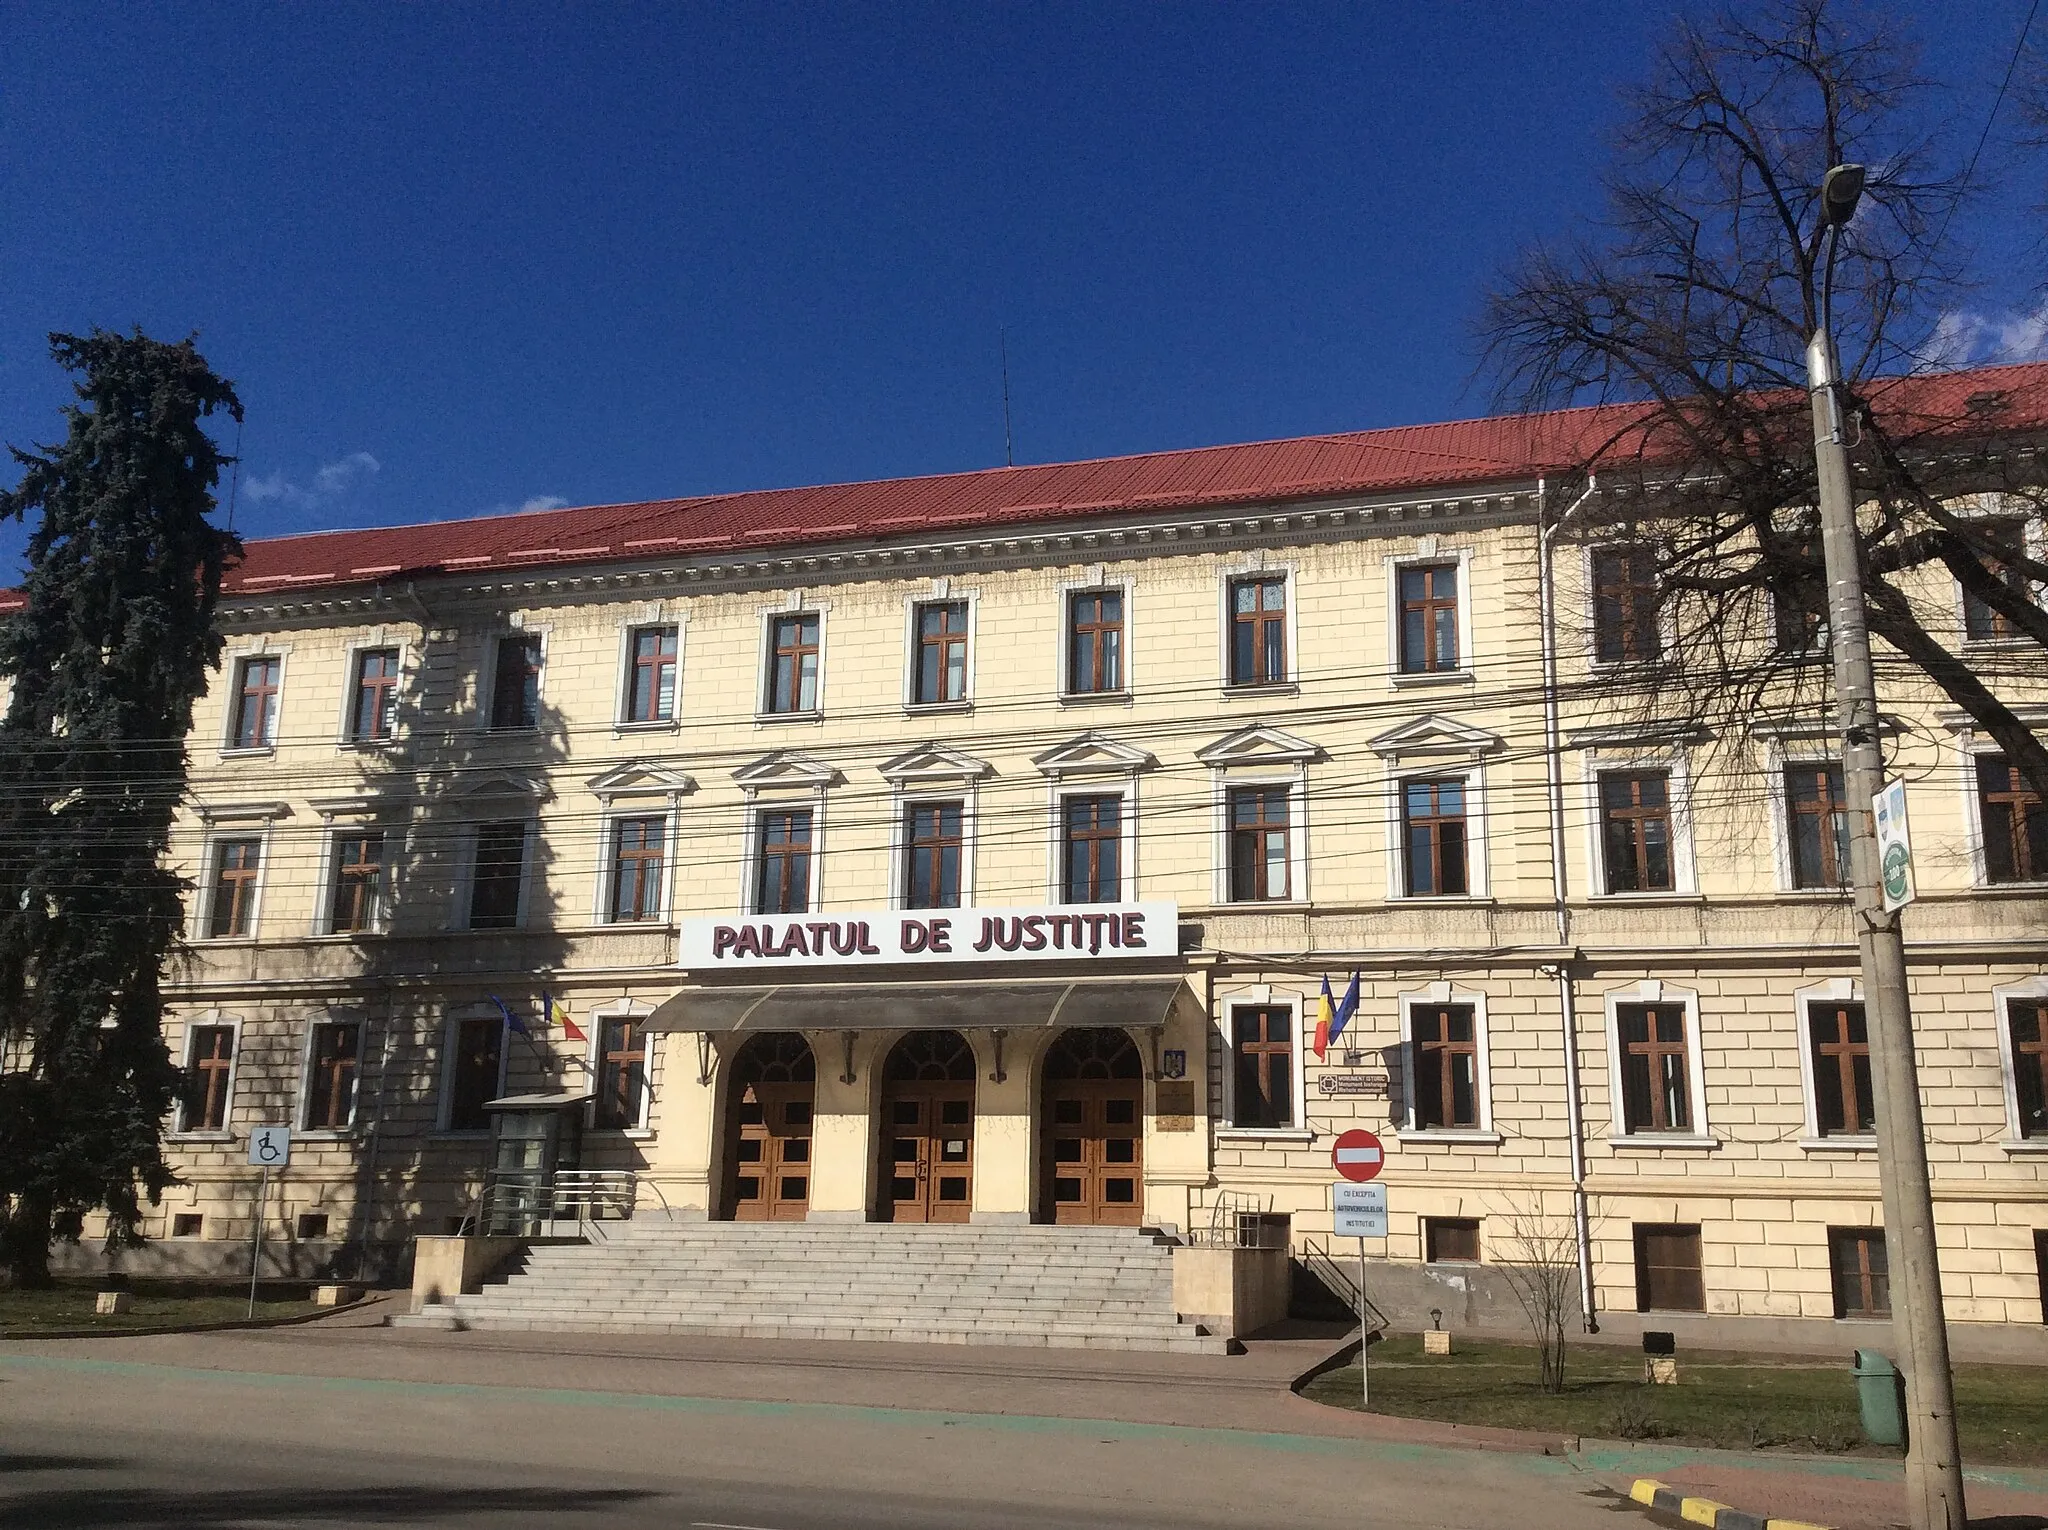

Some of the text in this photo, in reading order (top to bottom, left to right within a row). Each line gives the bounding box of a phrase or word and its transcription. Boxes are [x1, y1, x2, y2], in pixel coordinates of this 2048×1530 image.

[712, 912, 1147, 959] PALATUL DE JUSTIȚIE
[1337, 1204, 1384, 1213] AUTOVEHICULELOR
